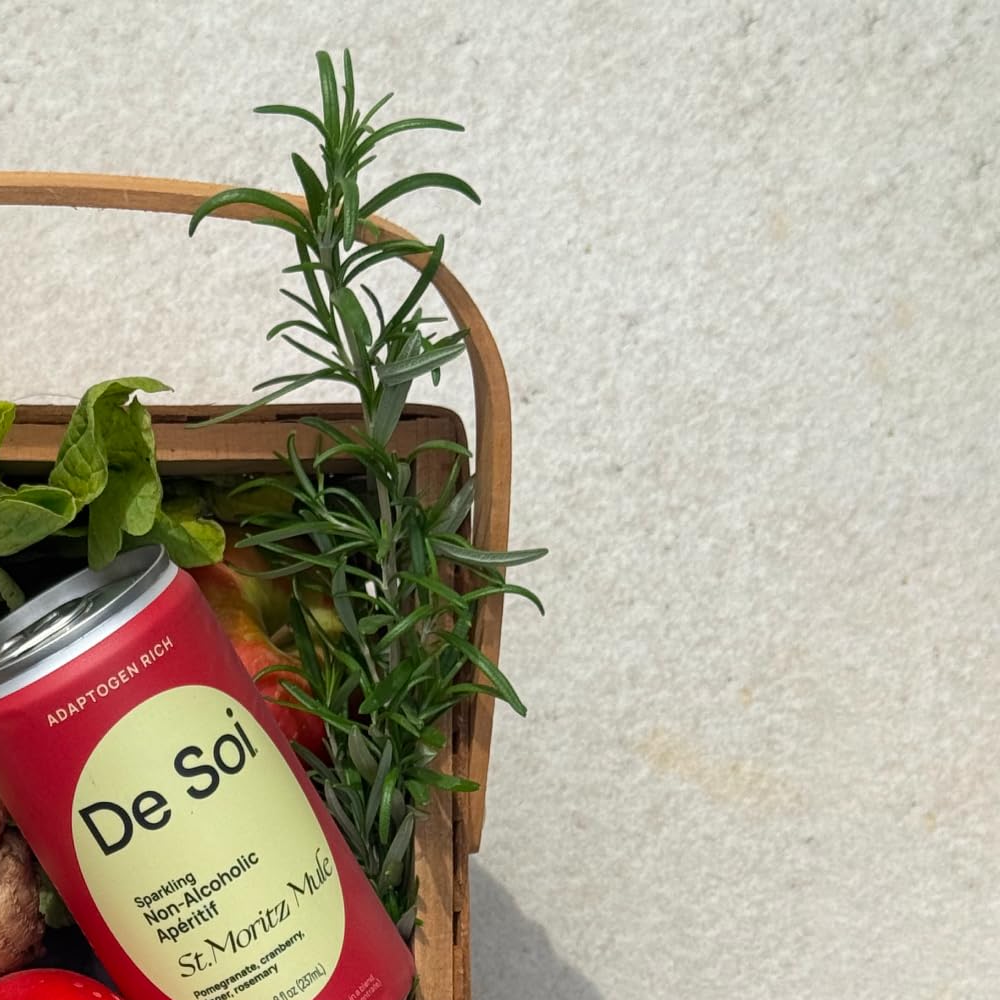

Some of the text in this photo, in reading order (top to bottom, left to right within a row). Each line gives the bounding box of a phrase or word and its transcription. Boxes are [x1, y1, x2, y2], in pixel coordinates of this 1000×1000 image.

[47, 636, 174, 727] ADAPTOGEN RICH
[78, 707, 258, 856] De Soi
[134, 871, 197, 909] Sparkling
[143, 851, 260, 926] Non-Alcoholic
[286, 847, 333, 908] Mule
[156, 900, 220, 944] Apéritif
[193, 929, 305, 1000] Pomegranate, cranberry,
[233, 962, 279, 995] rosemary
[286, 987, 299, 998] oz
